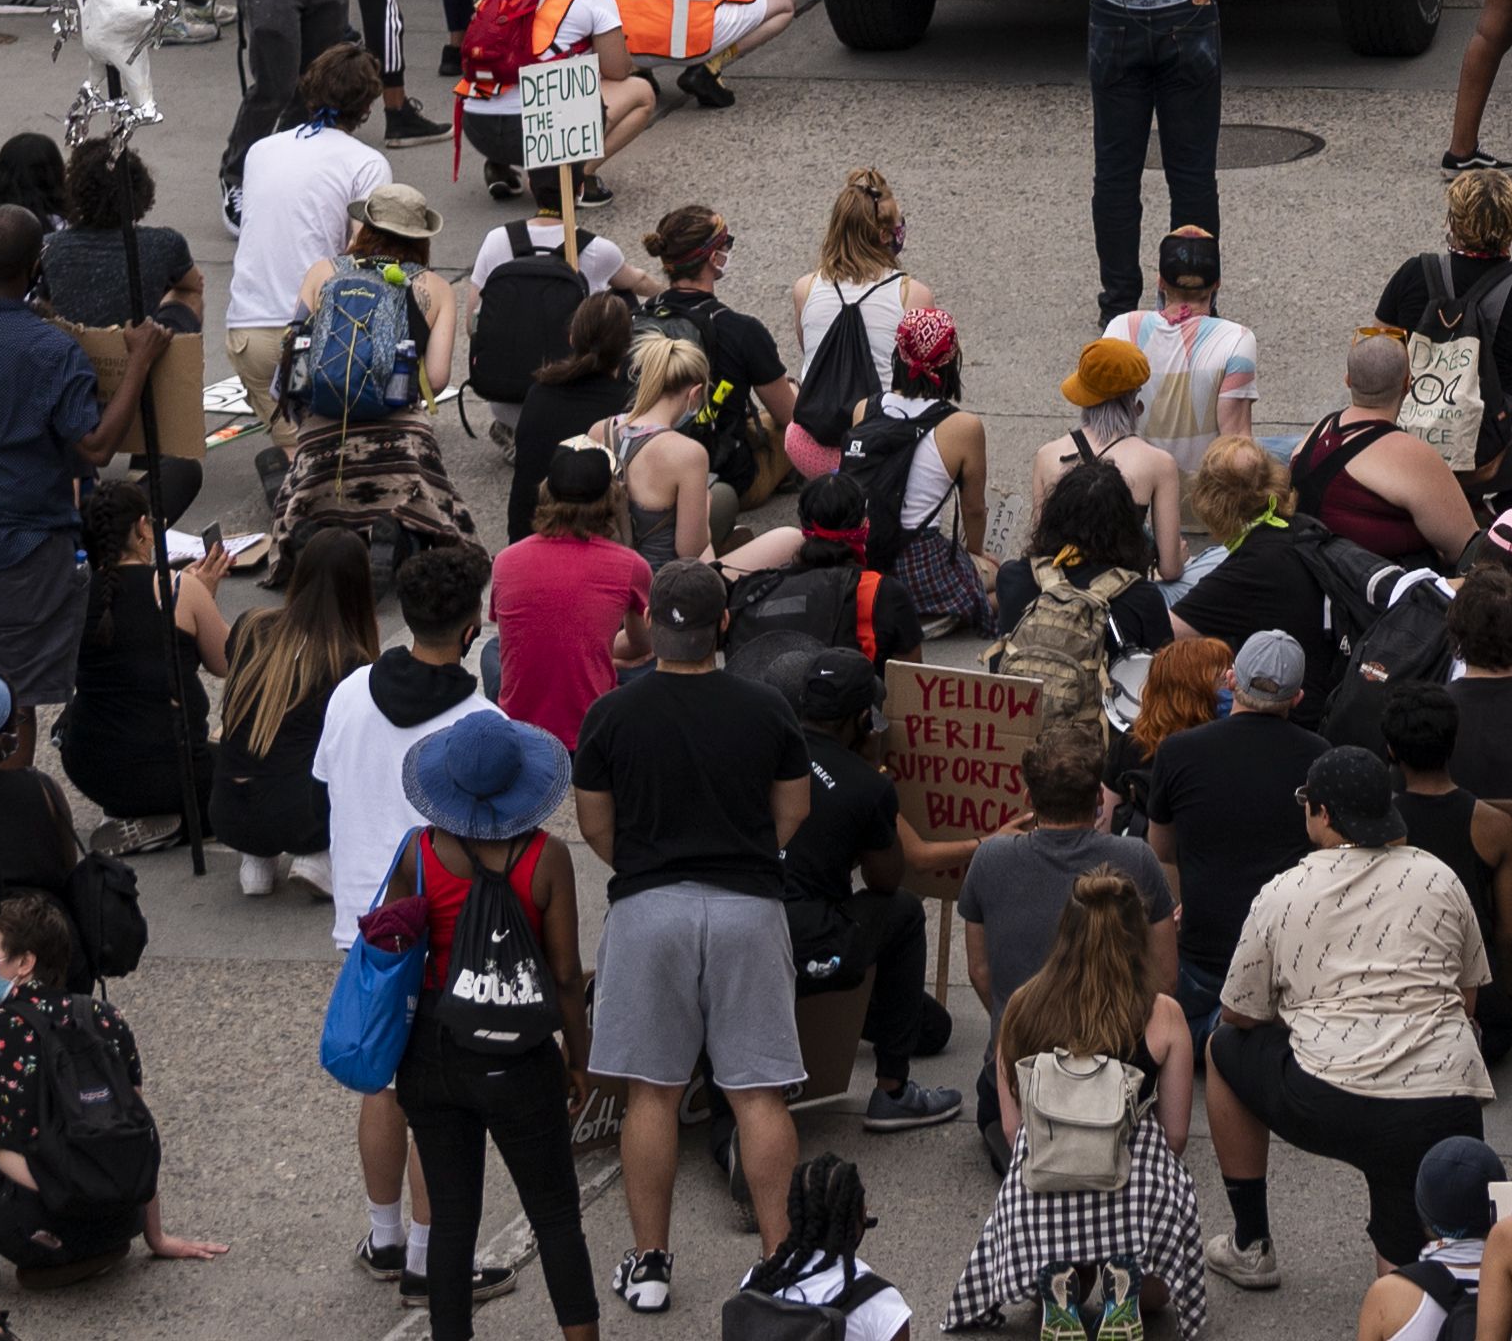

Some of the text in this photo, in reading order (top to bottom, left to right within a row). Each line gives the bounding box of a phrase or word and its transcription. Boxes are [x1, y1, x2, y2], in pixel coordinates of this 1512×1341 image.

[521, 67, 598, 108] DEFUND
[523, 114, 554, 134] THE
[524, 122, 599, 164] POLICE!
[914, 672, 1040, 722] YELLOW
[904, 714, 1005, 752] PERIL
[885, 753, 1024, 793] SUPPORTS
[927, 796, 1020, 832] BLACK
